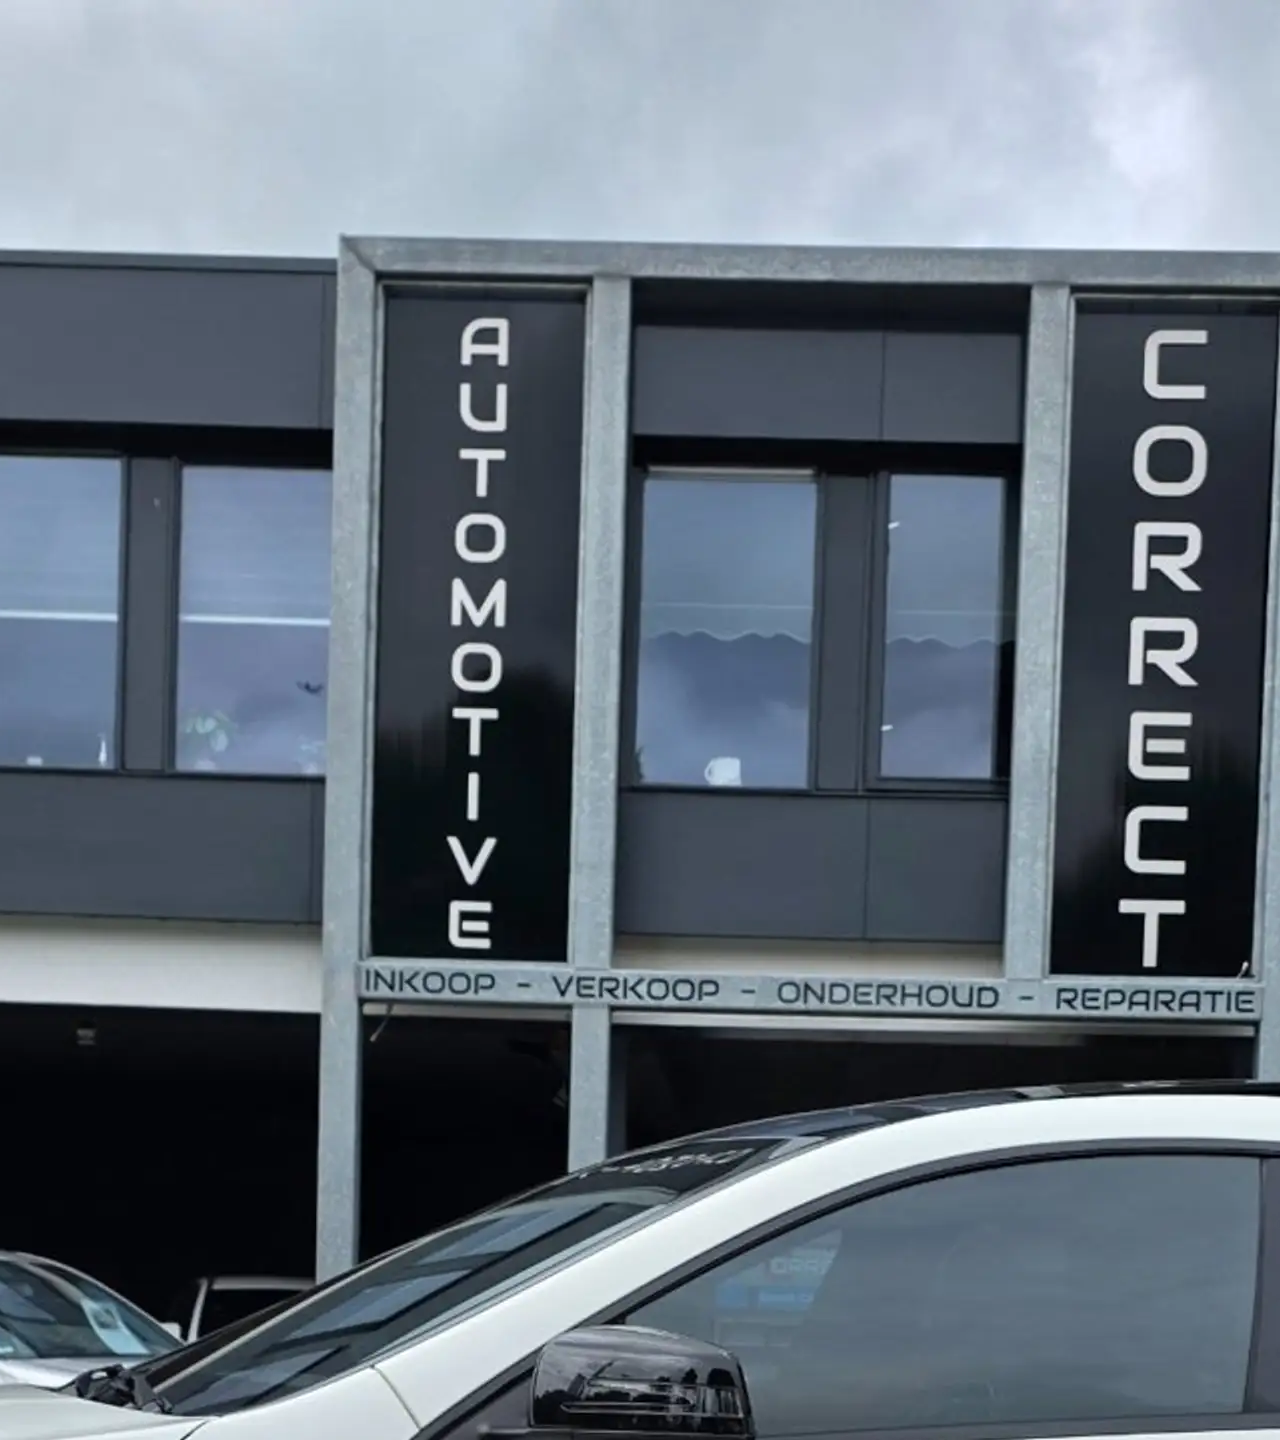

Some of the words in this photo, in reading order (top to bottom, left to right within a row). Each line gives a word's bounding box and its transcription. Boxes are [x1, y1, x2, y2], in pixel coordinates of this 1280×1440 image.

[446, 317, 509, 949] AUTOMOTIVE
[1118, 329, 1209, 968] CORRECT
[364, 970, 496, 995] INKOOP
[552, 975, 720, 1002] VERKOOP
[777, 981, 1000, 1009] ONDERHOUD
[1056, 987, 1256, 1013] REPARATIE
